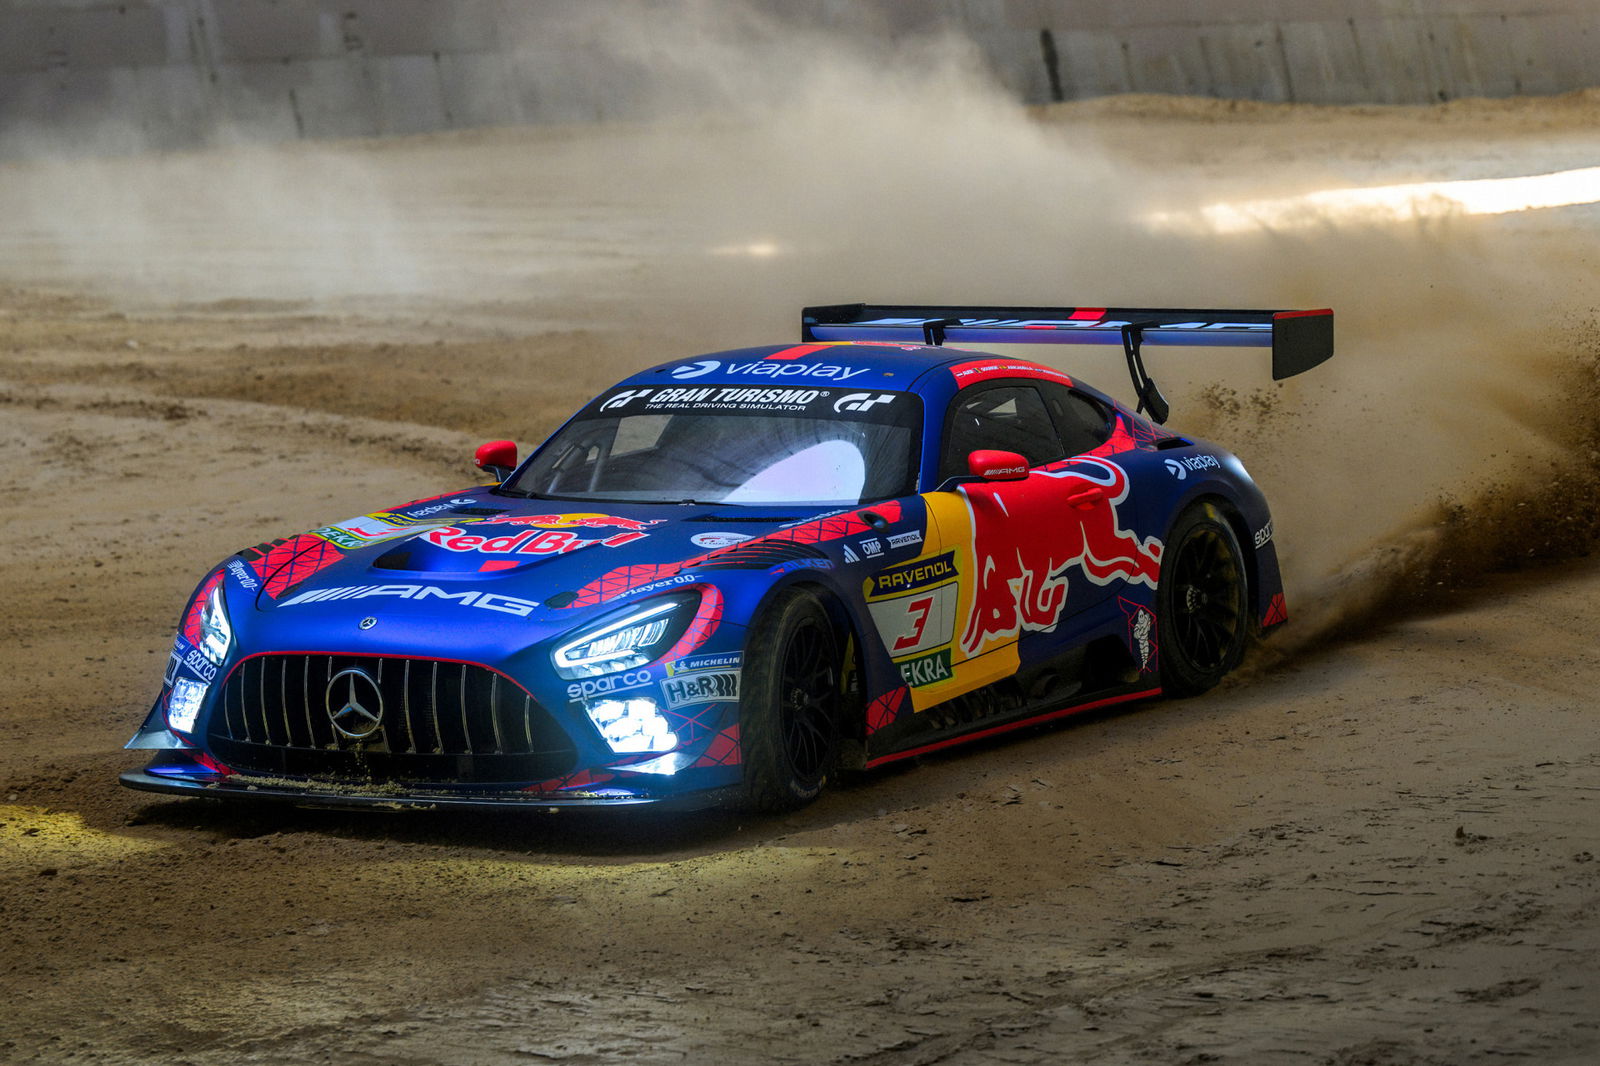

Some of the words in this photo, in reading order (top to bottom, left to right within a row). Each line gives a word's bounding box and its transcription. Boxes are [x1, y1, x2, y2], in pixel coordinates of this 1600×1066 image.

[726, 360, 870, 381] viaplay
[650, 388, 715, 402] GRAN
[999, 466, 1026, 475] AMG
[1181, 454, 1220, 470] viaplay
[421, 526, 542, 554] Red
[862, 541, 882, 555] OMP
[891, 533, 920, 545] RAVENOL
[878, 560, 952, 589] RAVENOL
[353, 584, 540, 617] AMG
[892, 594, 935, 651] 3
[186, 649, 217, 681] sparco
[690, 657, 740, 668] MICHELIN
[567, 670, 652, 701] sparco
[666, 674, 716, 702] H&R
